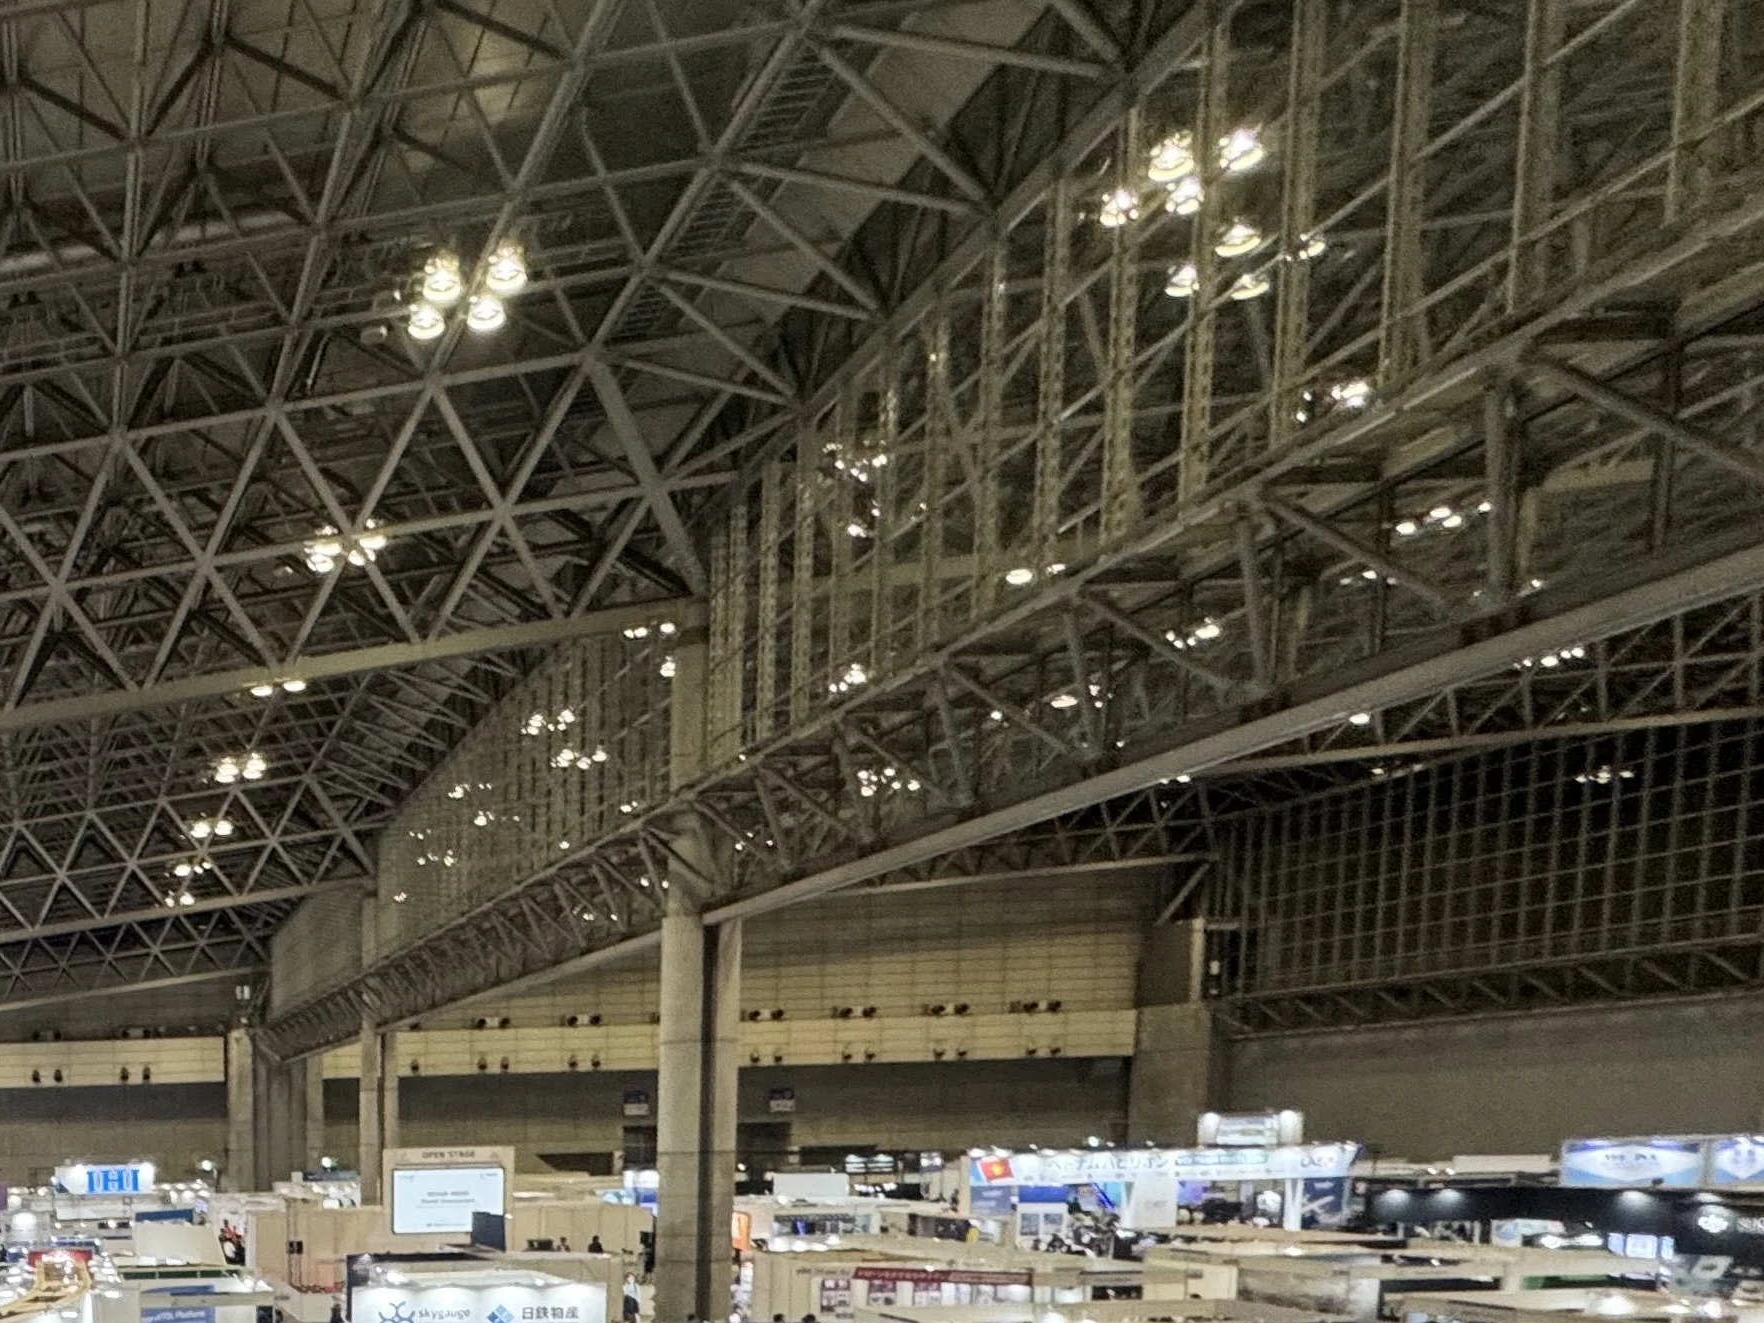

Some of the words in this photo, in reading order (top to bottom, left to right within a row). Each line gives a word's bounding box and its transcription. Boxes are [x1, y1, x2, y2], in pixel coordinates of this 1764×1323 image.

[87, 1169, 140, 1193] IHI
[418, 1308, 471, 1321] skygauge
[521, 1306, 579, 1321] 日鉄物産
